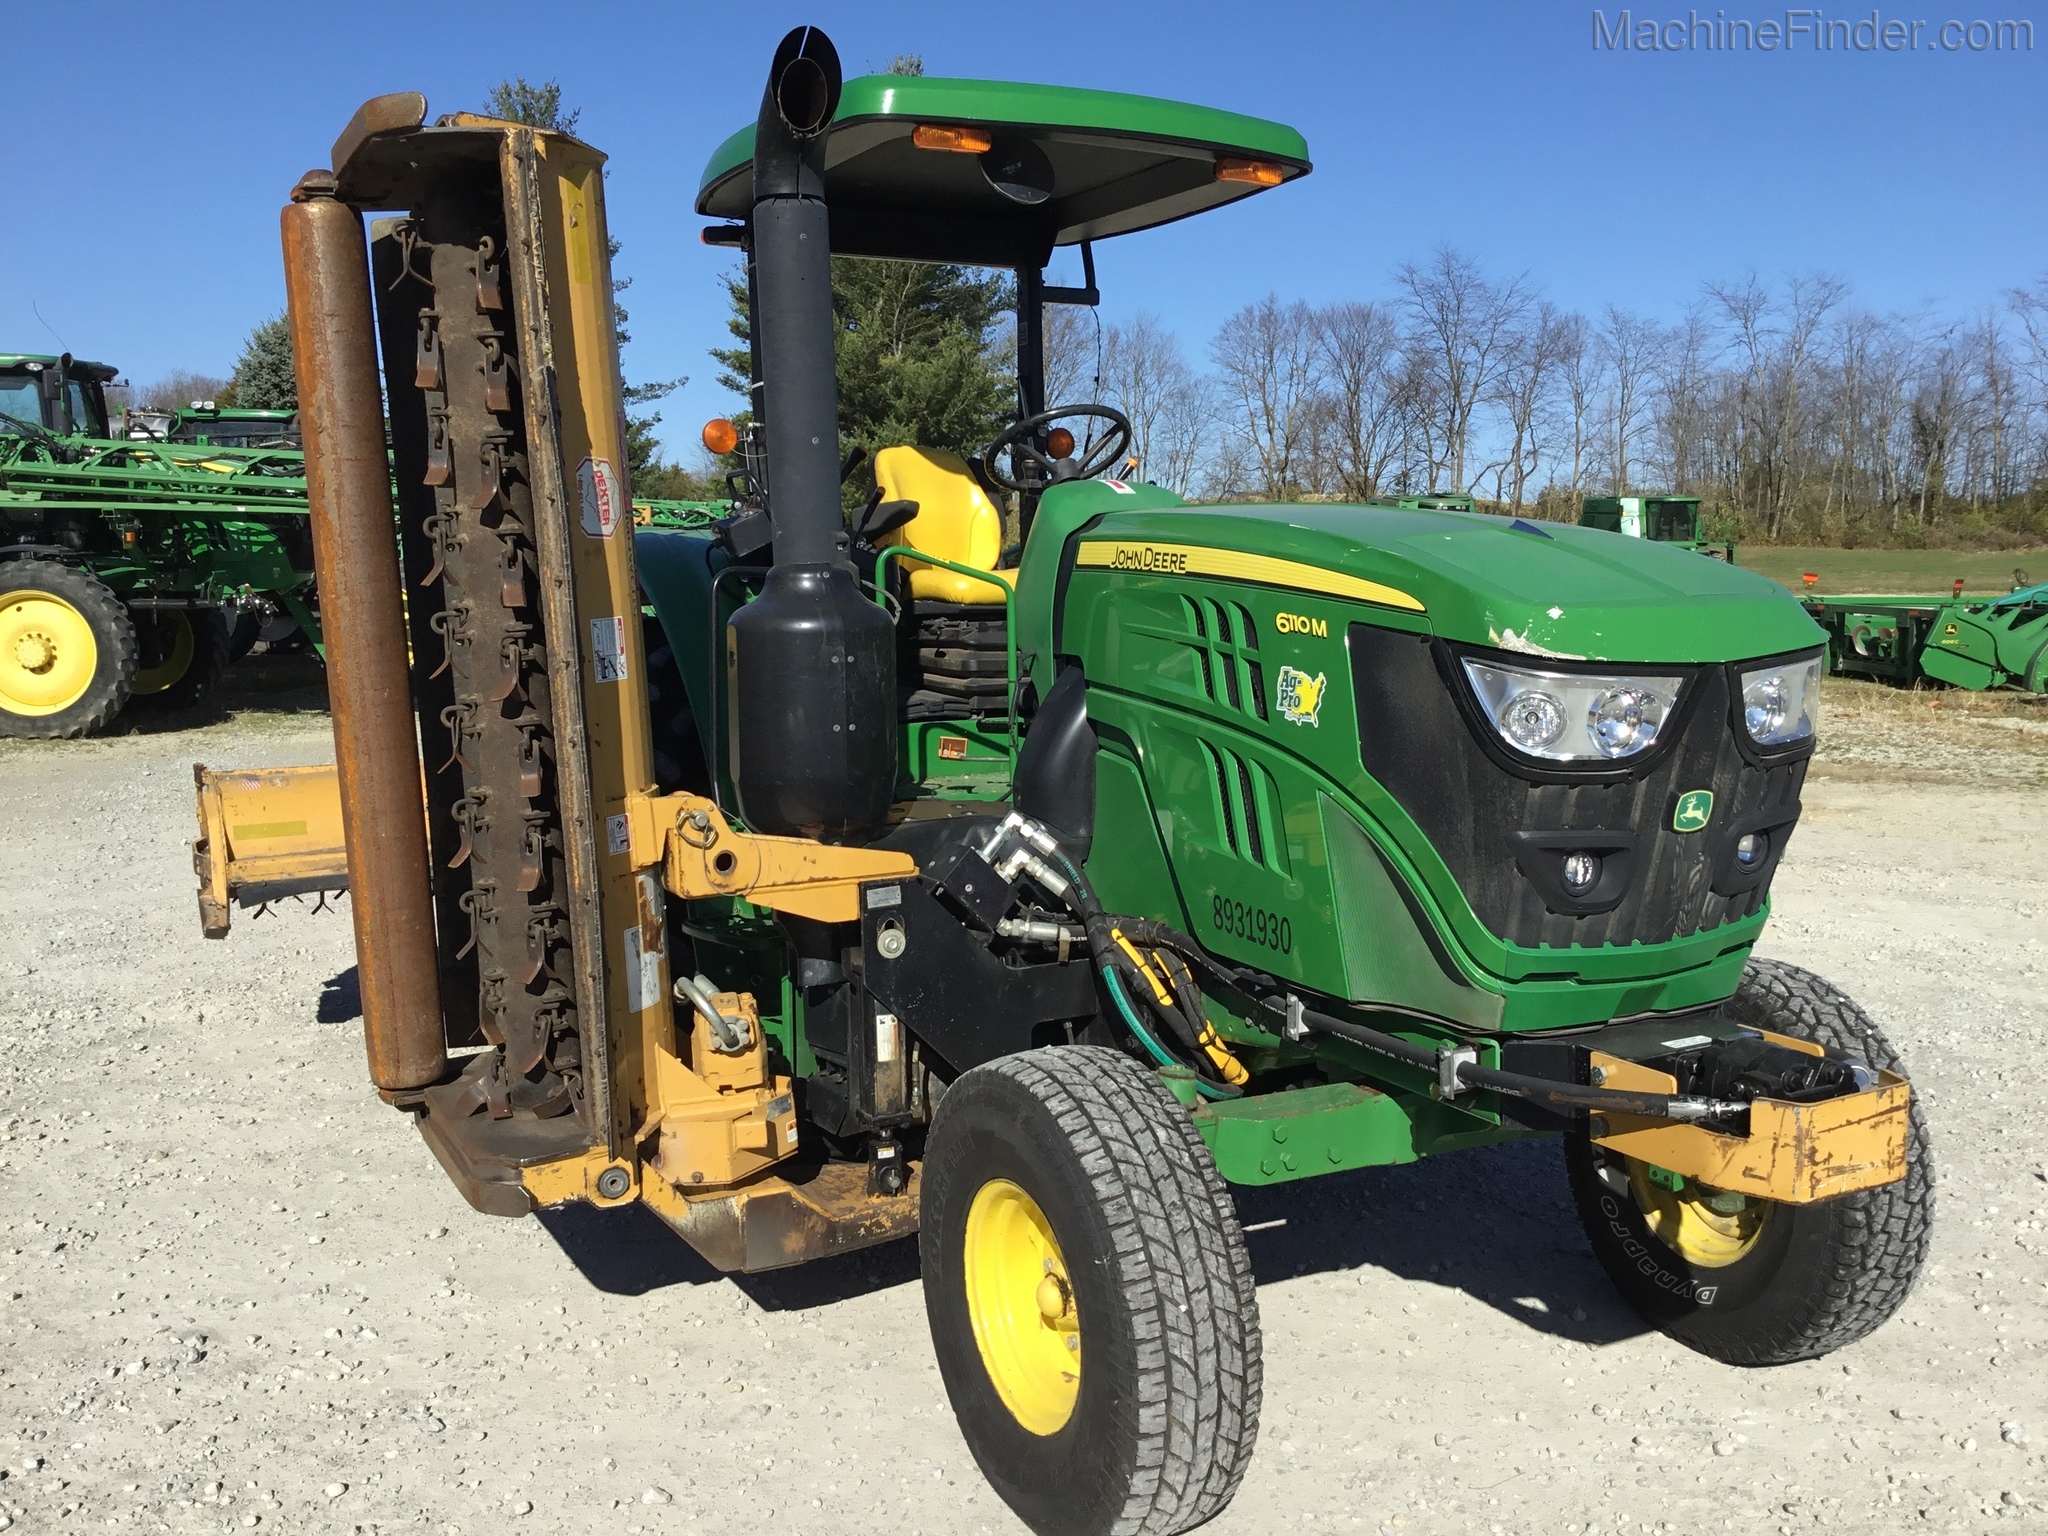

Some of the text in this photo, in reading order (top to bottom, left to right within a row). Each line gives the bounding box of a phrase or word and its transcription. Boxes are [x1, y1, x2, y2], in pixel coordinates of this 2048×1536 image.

[593, 470, 611, 526] DEXTER
[1111, 546, 1188, 571] JOHN DEERE
[1280, 690, 1302, 709] Pro
[1213, 894, 1292, 955] 8931930
[1600, 1194, 1719, 1306] Dynapro
